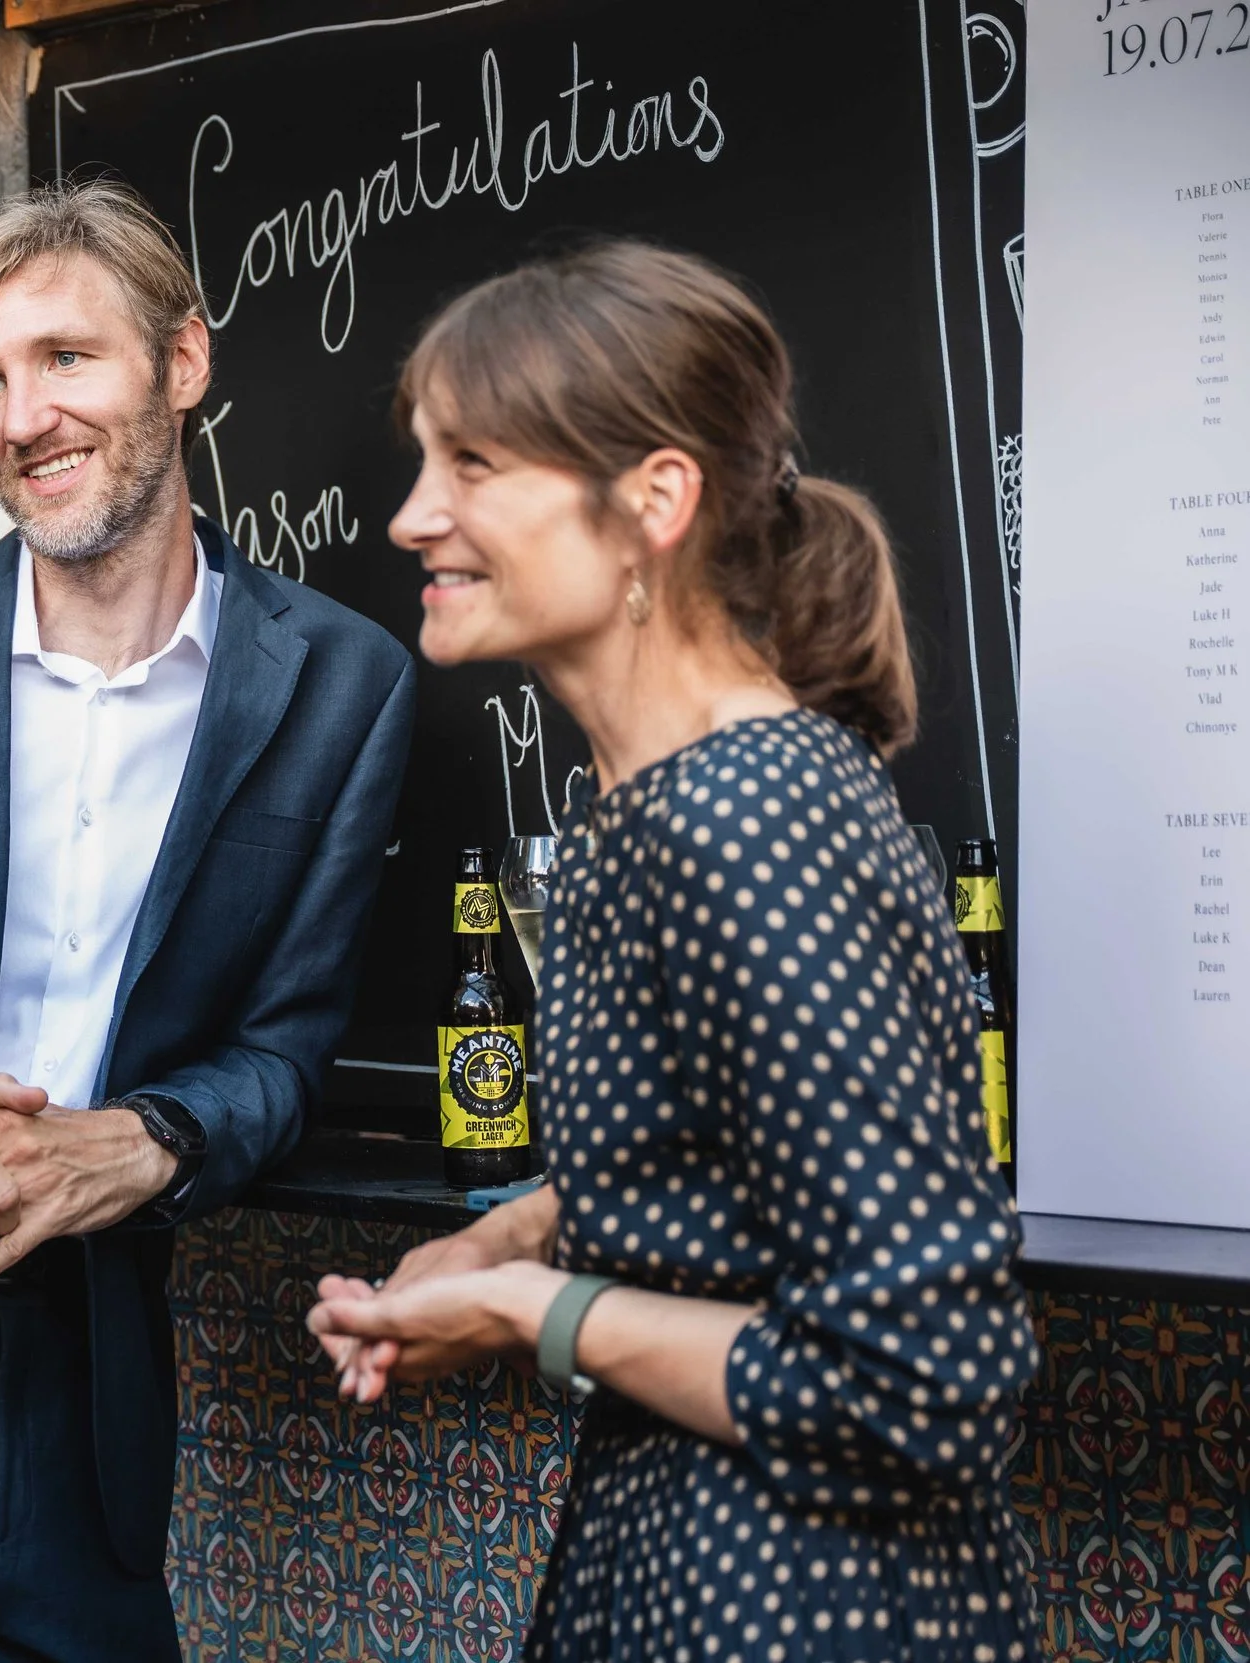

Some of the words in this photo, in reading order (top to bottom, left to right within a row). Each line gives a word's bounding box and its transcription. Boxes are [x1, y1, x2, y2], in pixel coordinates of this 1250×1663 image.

[1175, 182, 1218, 201] TABLE
[1222, 178, 1250, 194] ONE
[190, 42, 725, 353] Congratulations
[1202, 212, 1224, 222] Flora
[1198, 232, 1228, 242] Valerie
[1198, 252, 1227, 263] Dennis
[1198, 273, 1228, 283] Monica
[1199, 293, 1225, 304] Hilary
[1202, 312, 1223, 324] Andy
[1199, 334, 1226, 344] Edwin
[1200, 353, 1224, 364] Carol
[1196, 375, 1229, 385] Norman
[1204, 397, 1221, 405] Ann
[191, 401, 358, 584] Jason
[1169, 494, 1213, 510] TABLE
[1199, 527, 1226, 538] Anna
[1186, 553, 1238, 567] Katherine
[1199, 581, 1222, 595] Jade
[1193, 609, 1217, 621] Luke
[1189, 636, 1235, 650] Rochelle
[1186, 666, 1212, 680] Tony
[1216, 664, 1227, 676] M
[1230, 663, 1238, 676] K
[1198, 692, 1222, 704] Vlad
[1186, 721, 1238, 735] Chinonye
[1165, 813, 1209, 828] TABLE
[1202, 846, 1221, 858] Lee
[1200, 874, 1223, 887] Erin
[1194, 902, 1230, 915] Rachel
[1193, 931, 1218, 944] Luke
[1222, 932, 1230, 944] K
[1198, 960, 1225, 973] Dean
[1193, 989, 1231, 1001] Lauren
[452, 1035, 522, 1074] MEANTIME
[465, 1119, 517, 1133] GREENWICH
[481, 1131, 504, 1142] LAGER
